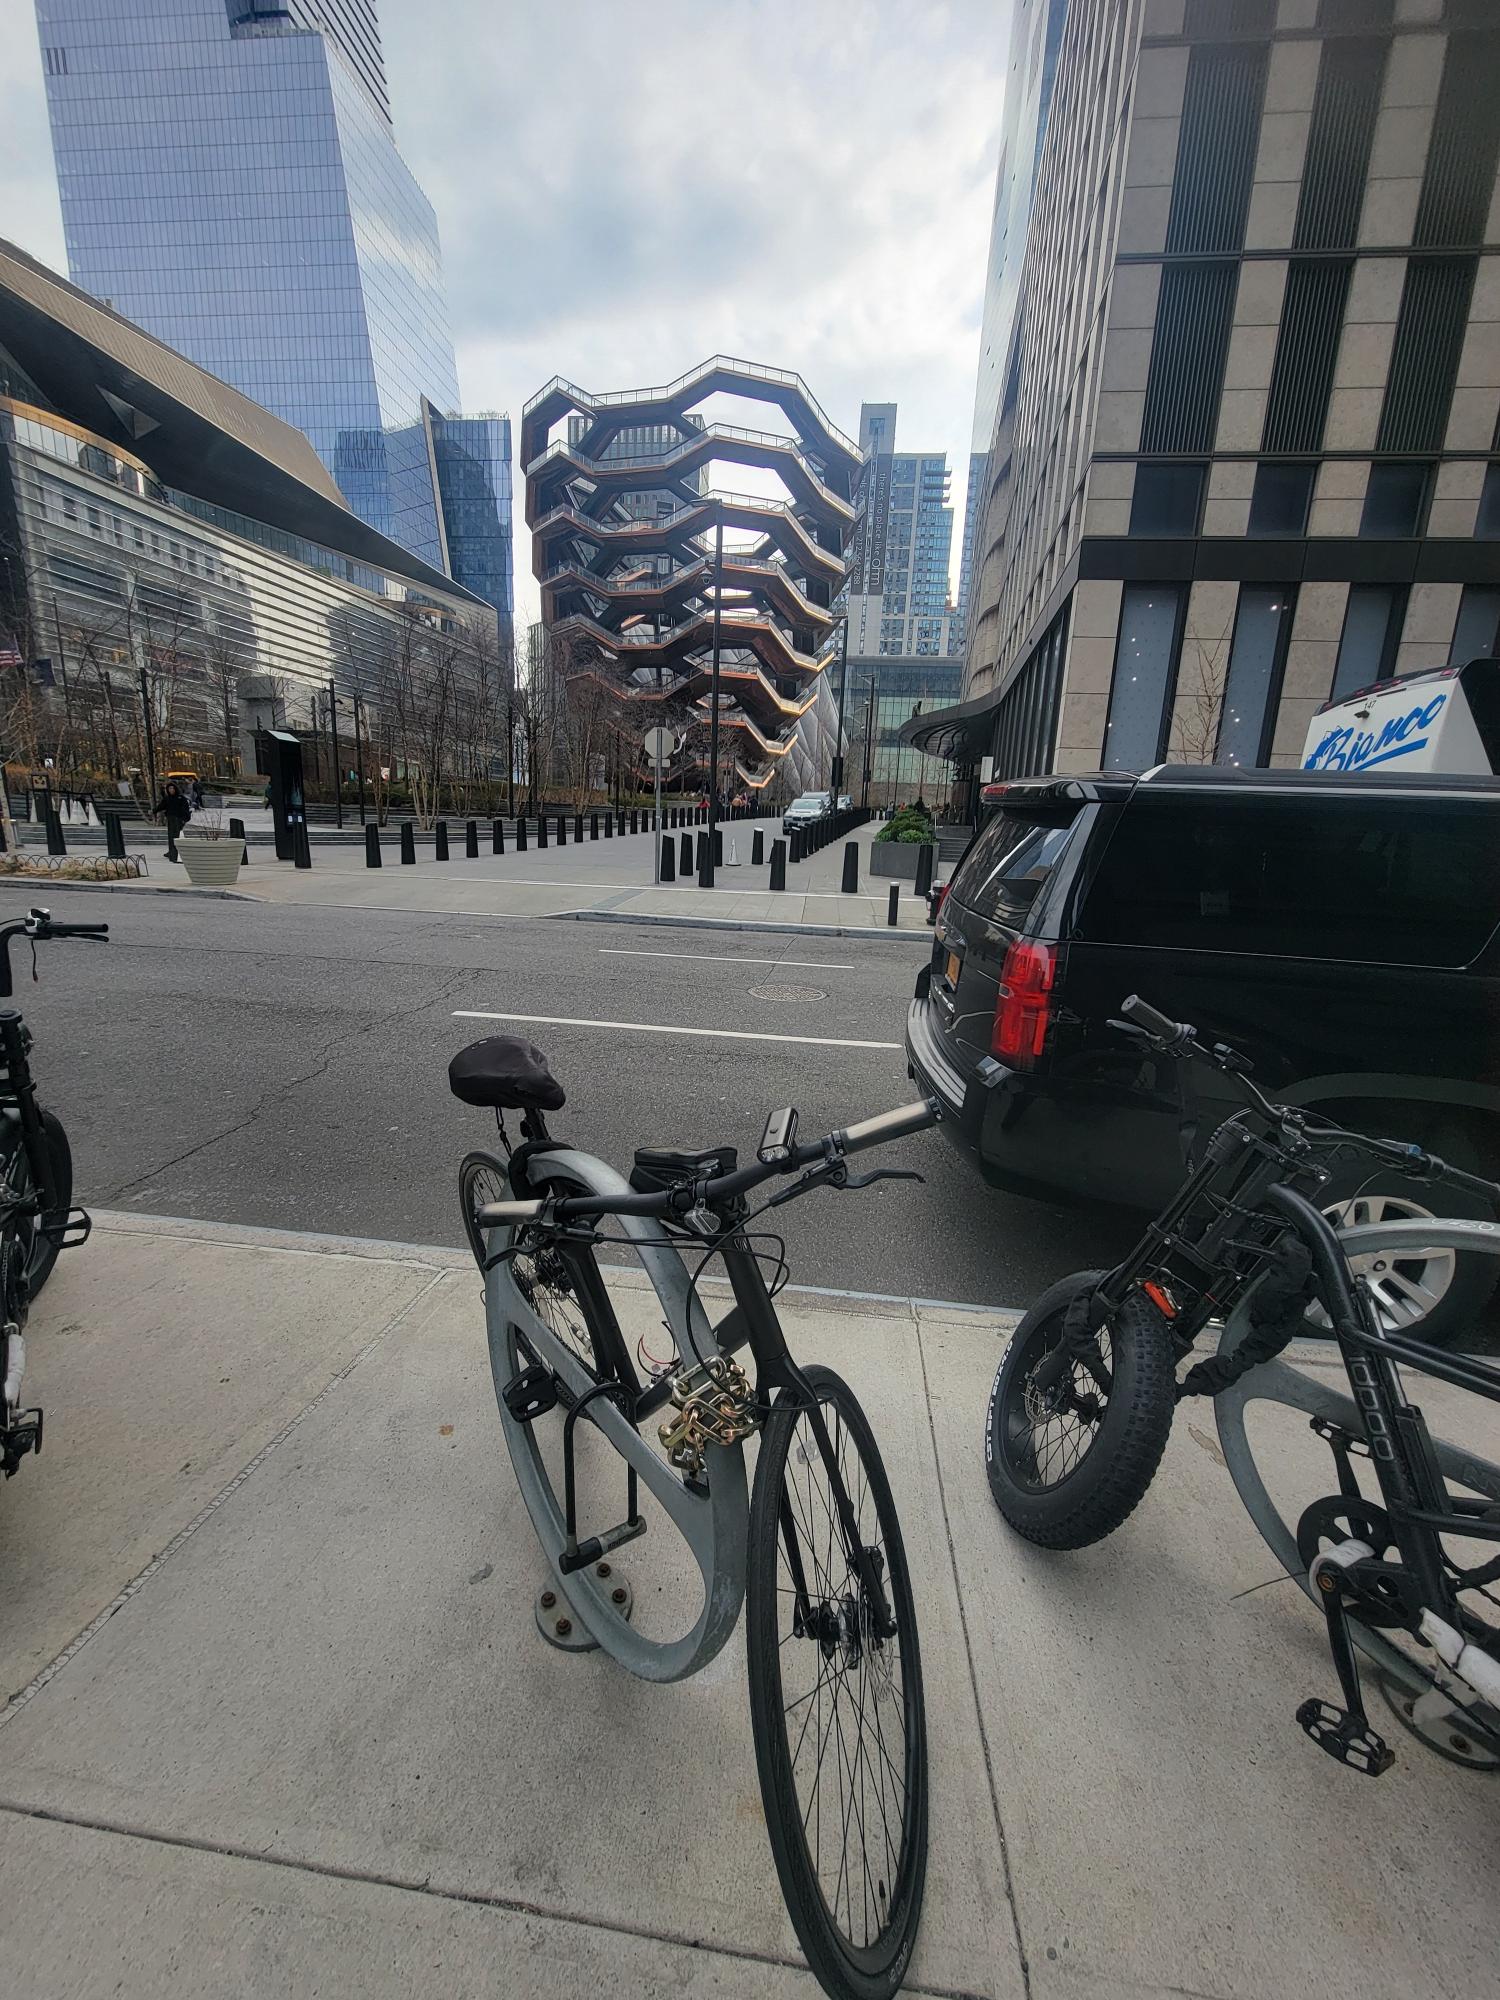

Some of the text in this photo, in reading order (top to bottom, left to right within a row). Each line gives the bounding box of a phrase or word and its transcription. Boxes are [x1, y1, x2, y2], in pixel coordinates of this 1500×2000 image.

[870, 473, 887, 586] there's no place like ohm
[1320, 694, 1448, 771] Bianco
